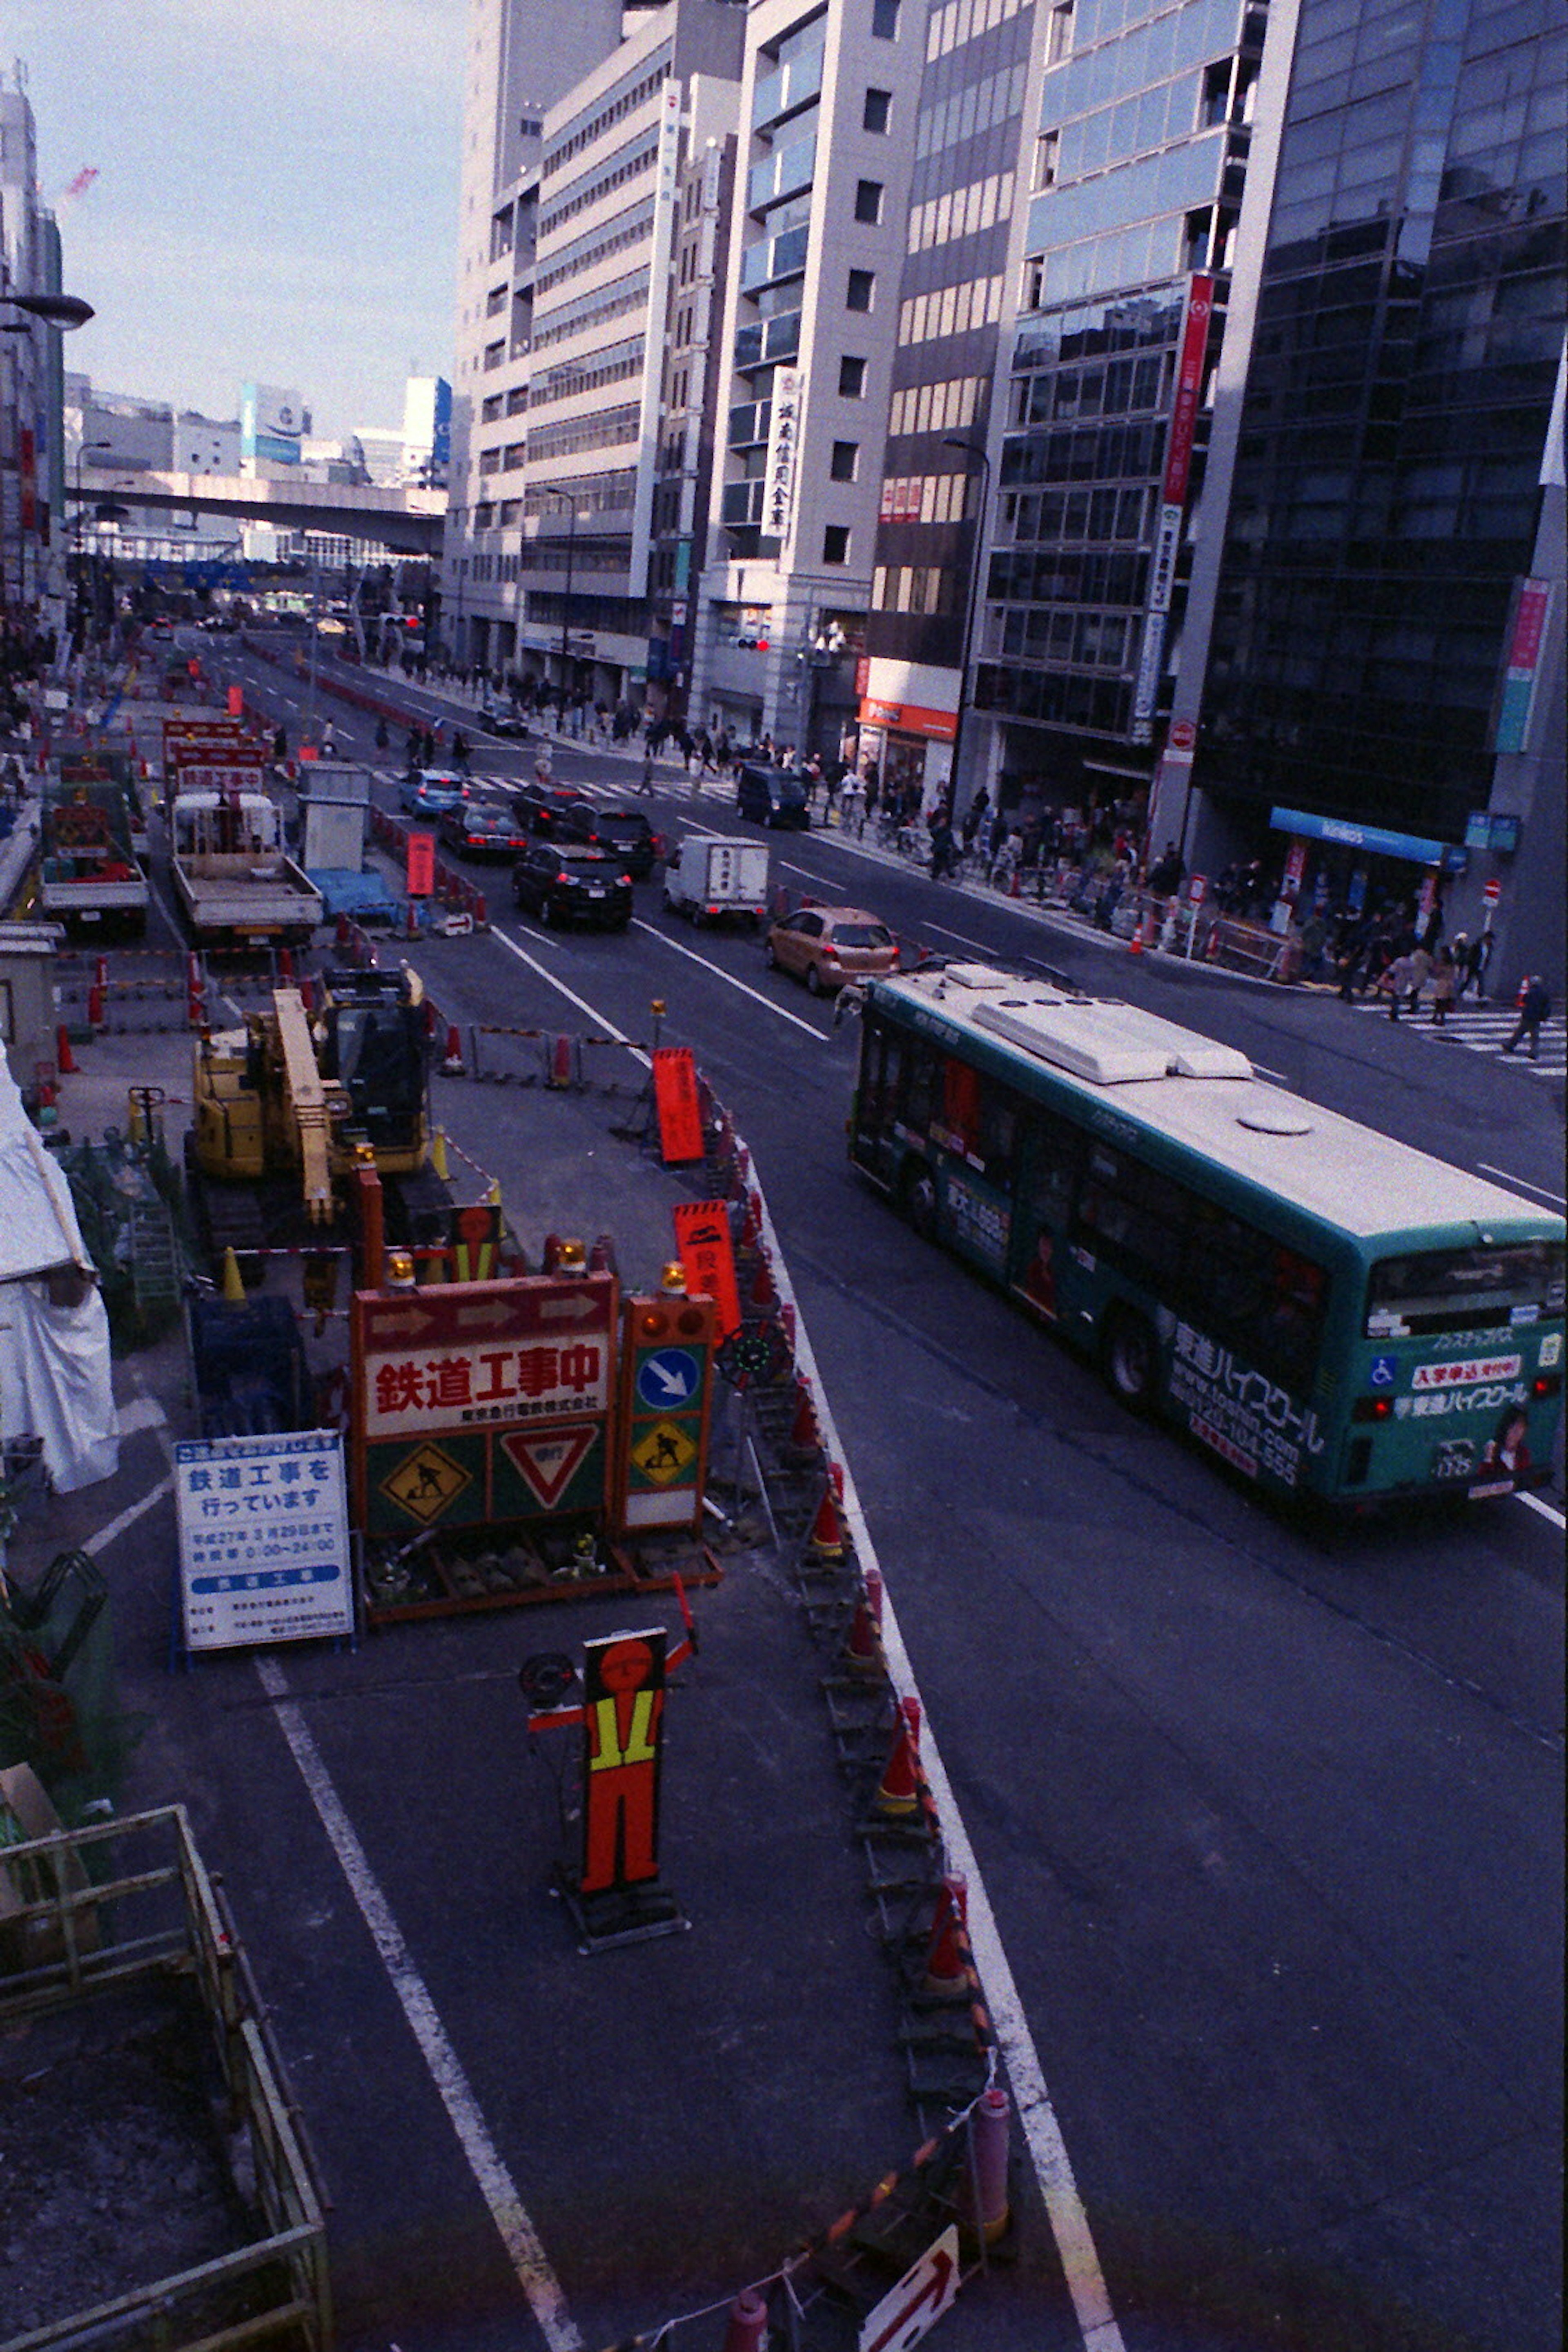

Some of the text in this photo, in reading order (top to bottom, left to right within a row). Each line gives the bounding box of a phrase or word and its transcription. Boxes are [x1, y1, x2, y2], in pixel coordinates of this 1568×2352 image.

[376, 1345, 600, 1413] 鉄道工事中
[189, 1459, 329, 1492] 鉄道工事を
[202, 1488, 320, 1517] 行っています
